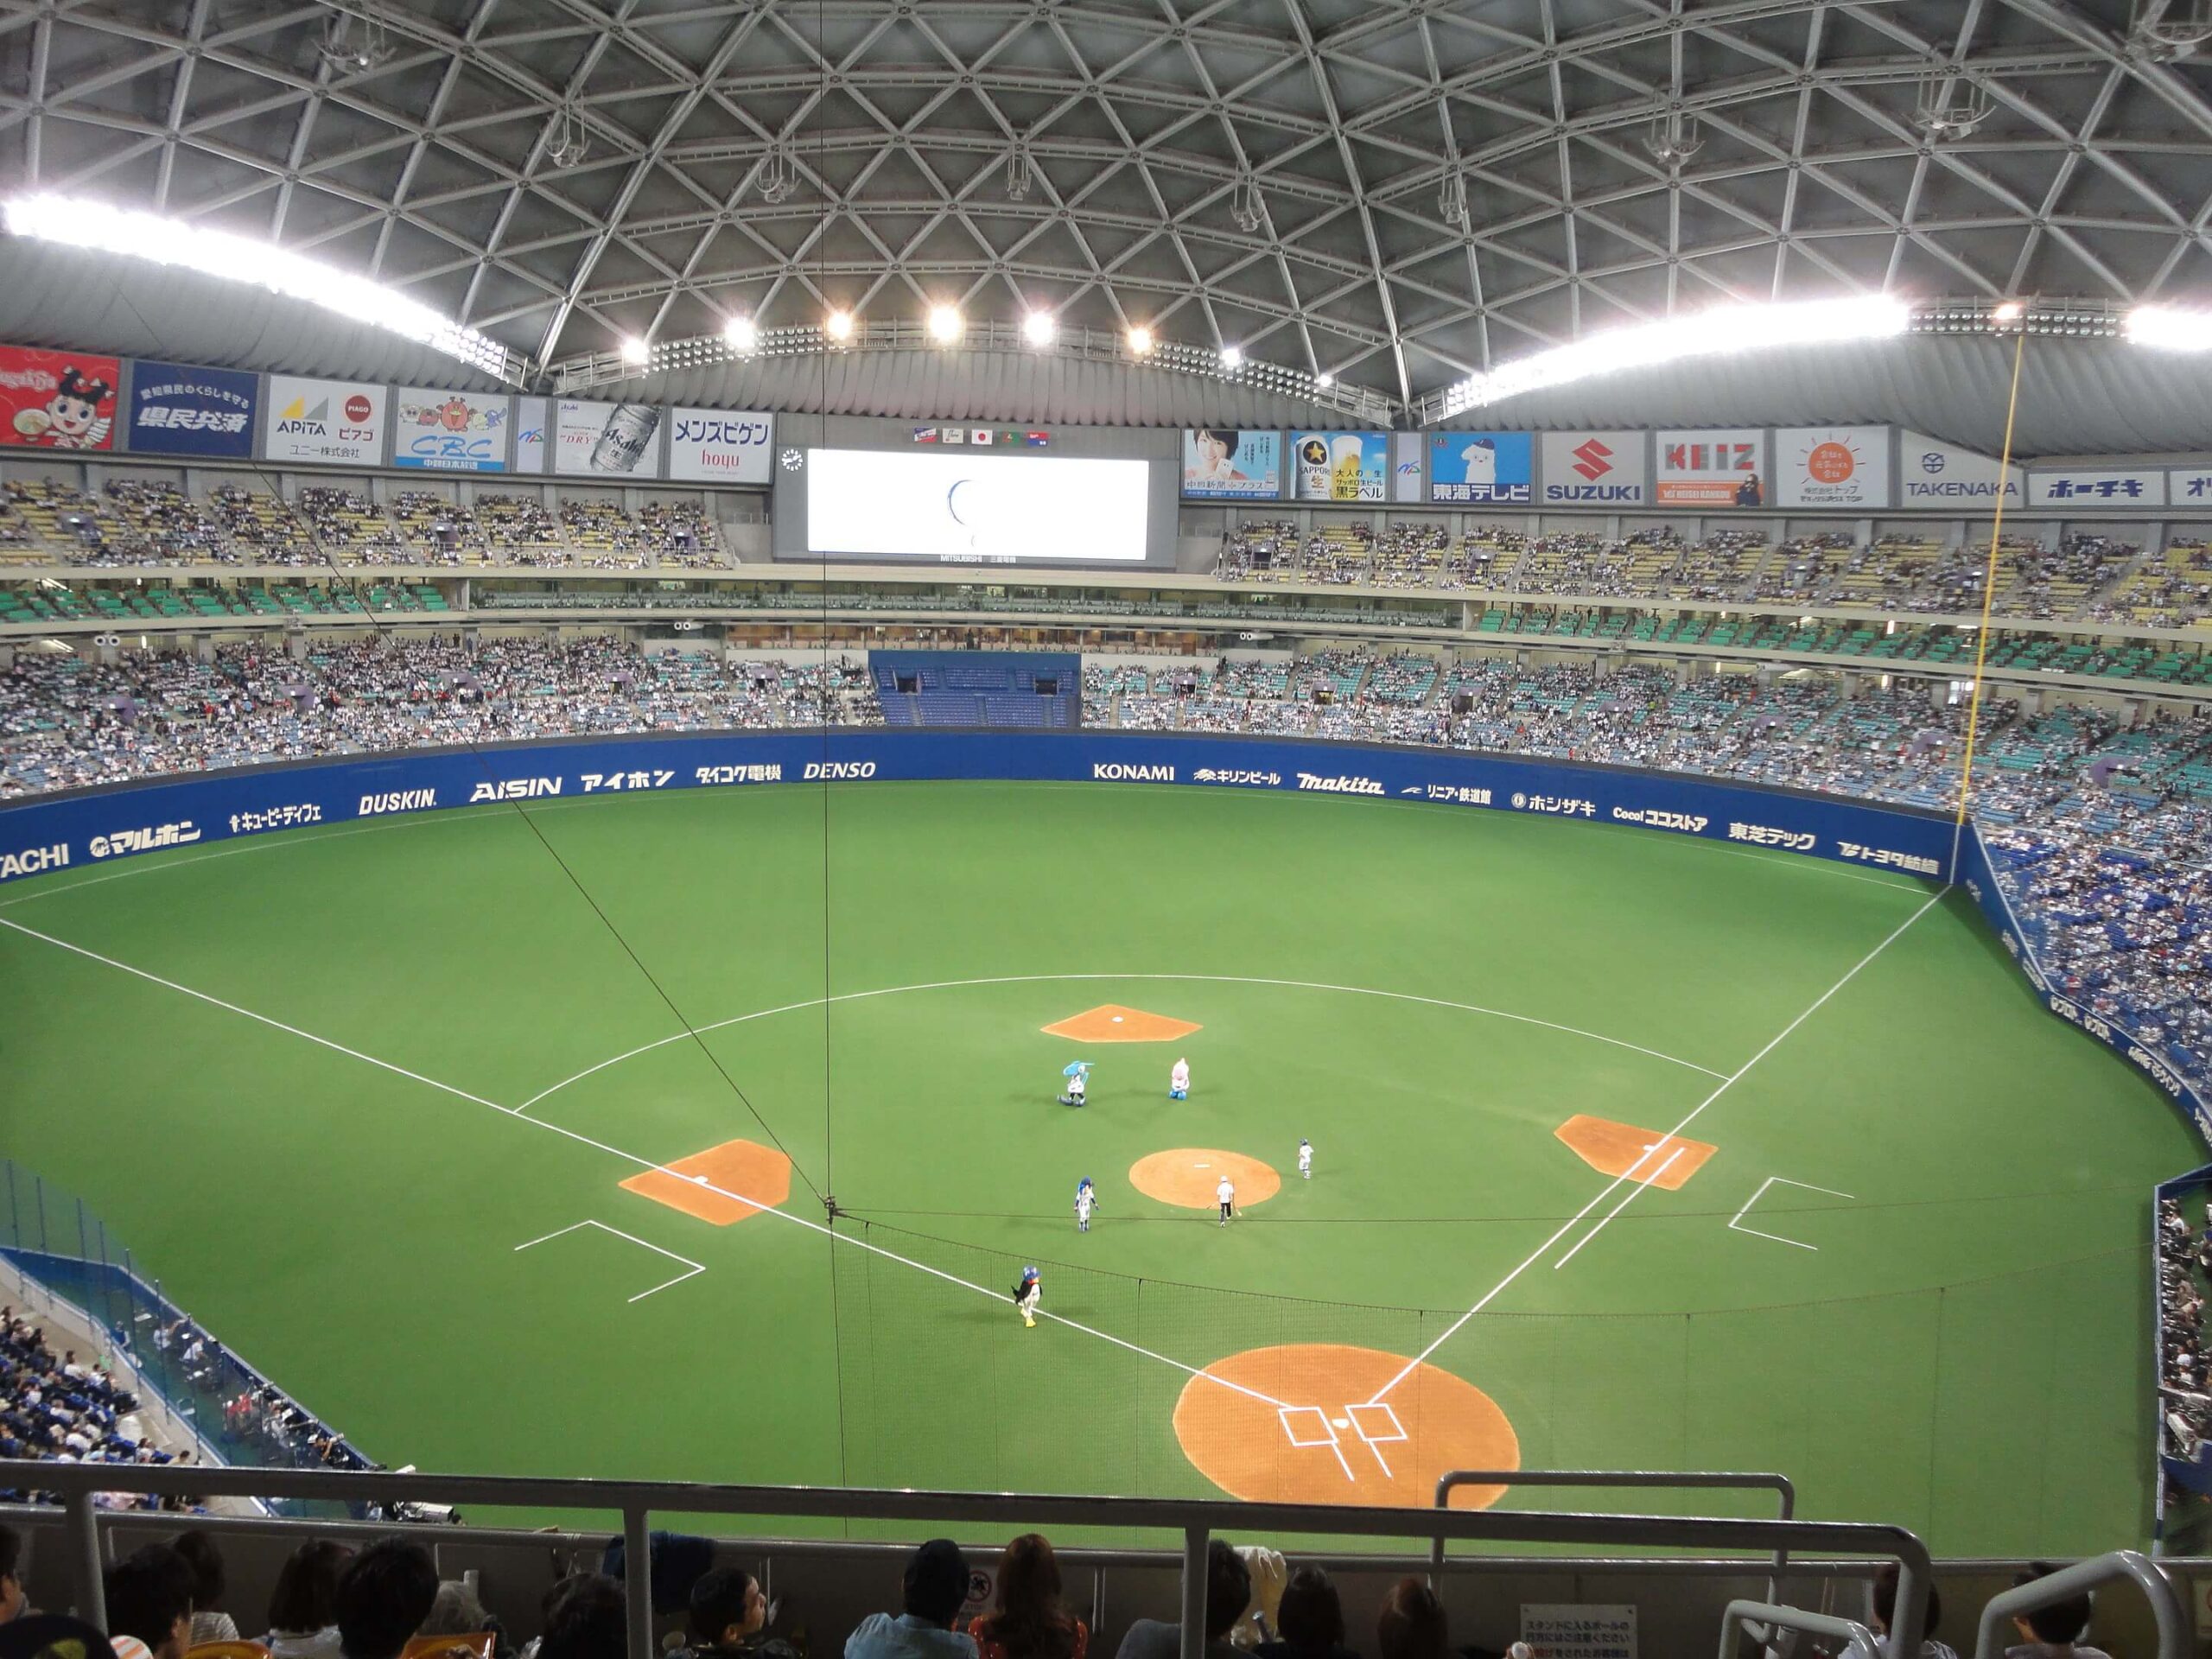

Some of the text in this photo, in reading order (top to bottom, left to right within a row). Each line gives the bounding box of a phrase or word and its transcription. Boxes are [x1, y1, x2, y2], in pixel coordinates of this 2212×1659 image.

[137, 407, 248, 433] 県民共済
[339, 428, 375, 442] ピアゴ
[675, 420, 768, 446] メンズビゲン
[289, 444, 359, 458] ユニー株式会社
[411, 435, 493, 459] CBC
[702, 448, 740, 469] hoyu
[1336, 486, 1382, 499] 黒ラベル
[1433, 484, 1529, 501] 東海テレビ
[1547, 485, 1640, 500] SUZUKI
[1906, 482, 2018, 496] TAKENAKA
[2048, 479, 2144, 499] ホーチキ
[940, 554, 982, 563] MITSUBISHI
[696, 764, 781, 784] ダイコク電機
[804, 762, 876, 779] DENSO
[1094, 764, 1174, 781] KONAMI
[1217, 769, 1281, 785] キリンビール
[469, 777, 562, 803] AISIN
[581, 771, 675, 791] アイホン
[359, 788, 435, 816] DUSKIN
[1427, 785, 1491, 804] リニア・鉄道館
[1529, 795, 1596, 817] ホシザキ
[1645, 810, 1708, 832] ココストア
[111, 821, 200, 854] マルホン
[1729, 823, 1816, 850] 東芝テック
[0, 843, 69, 878] ACHI
